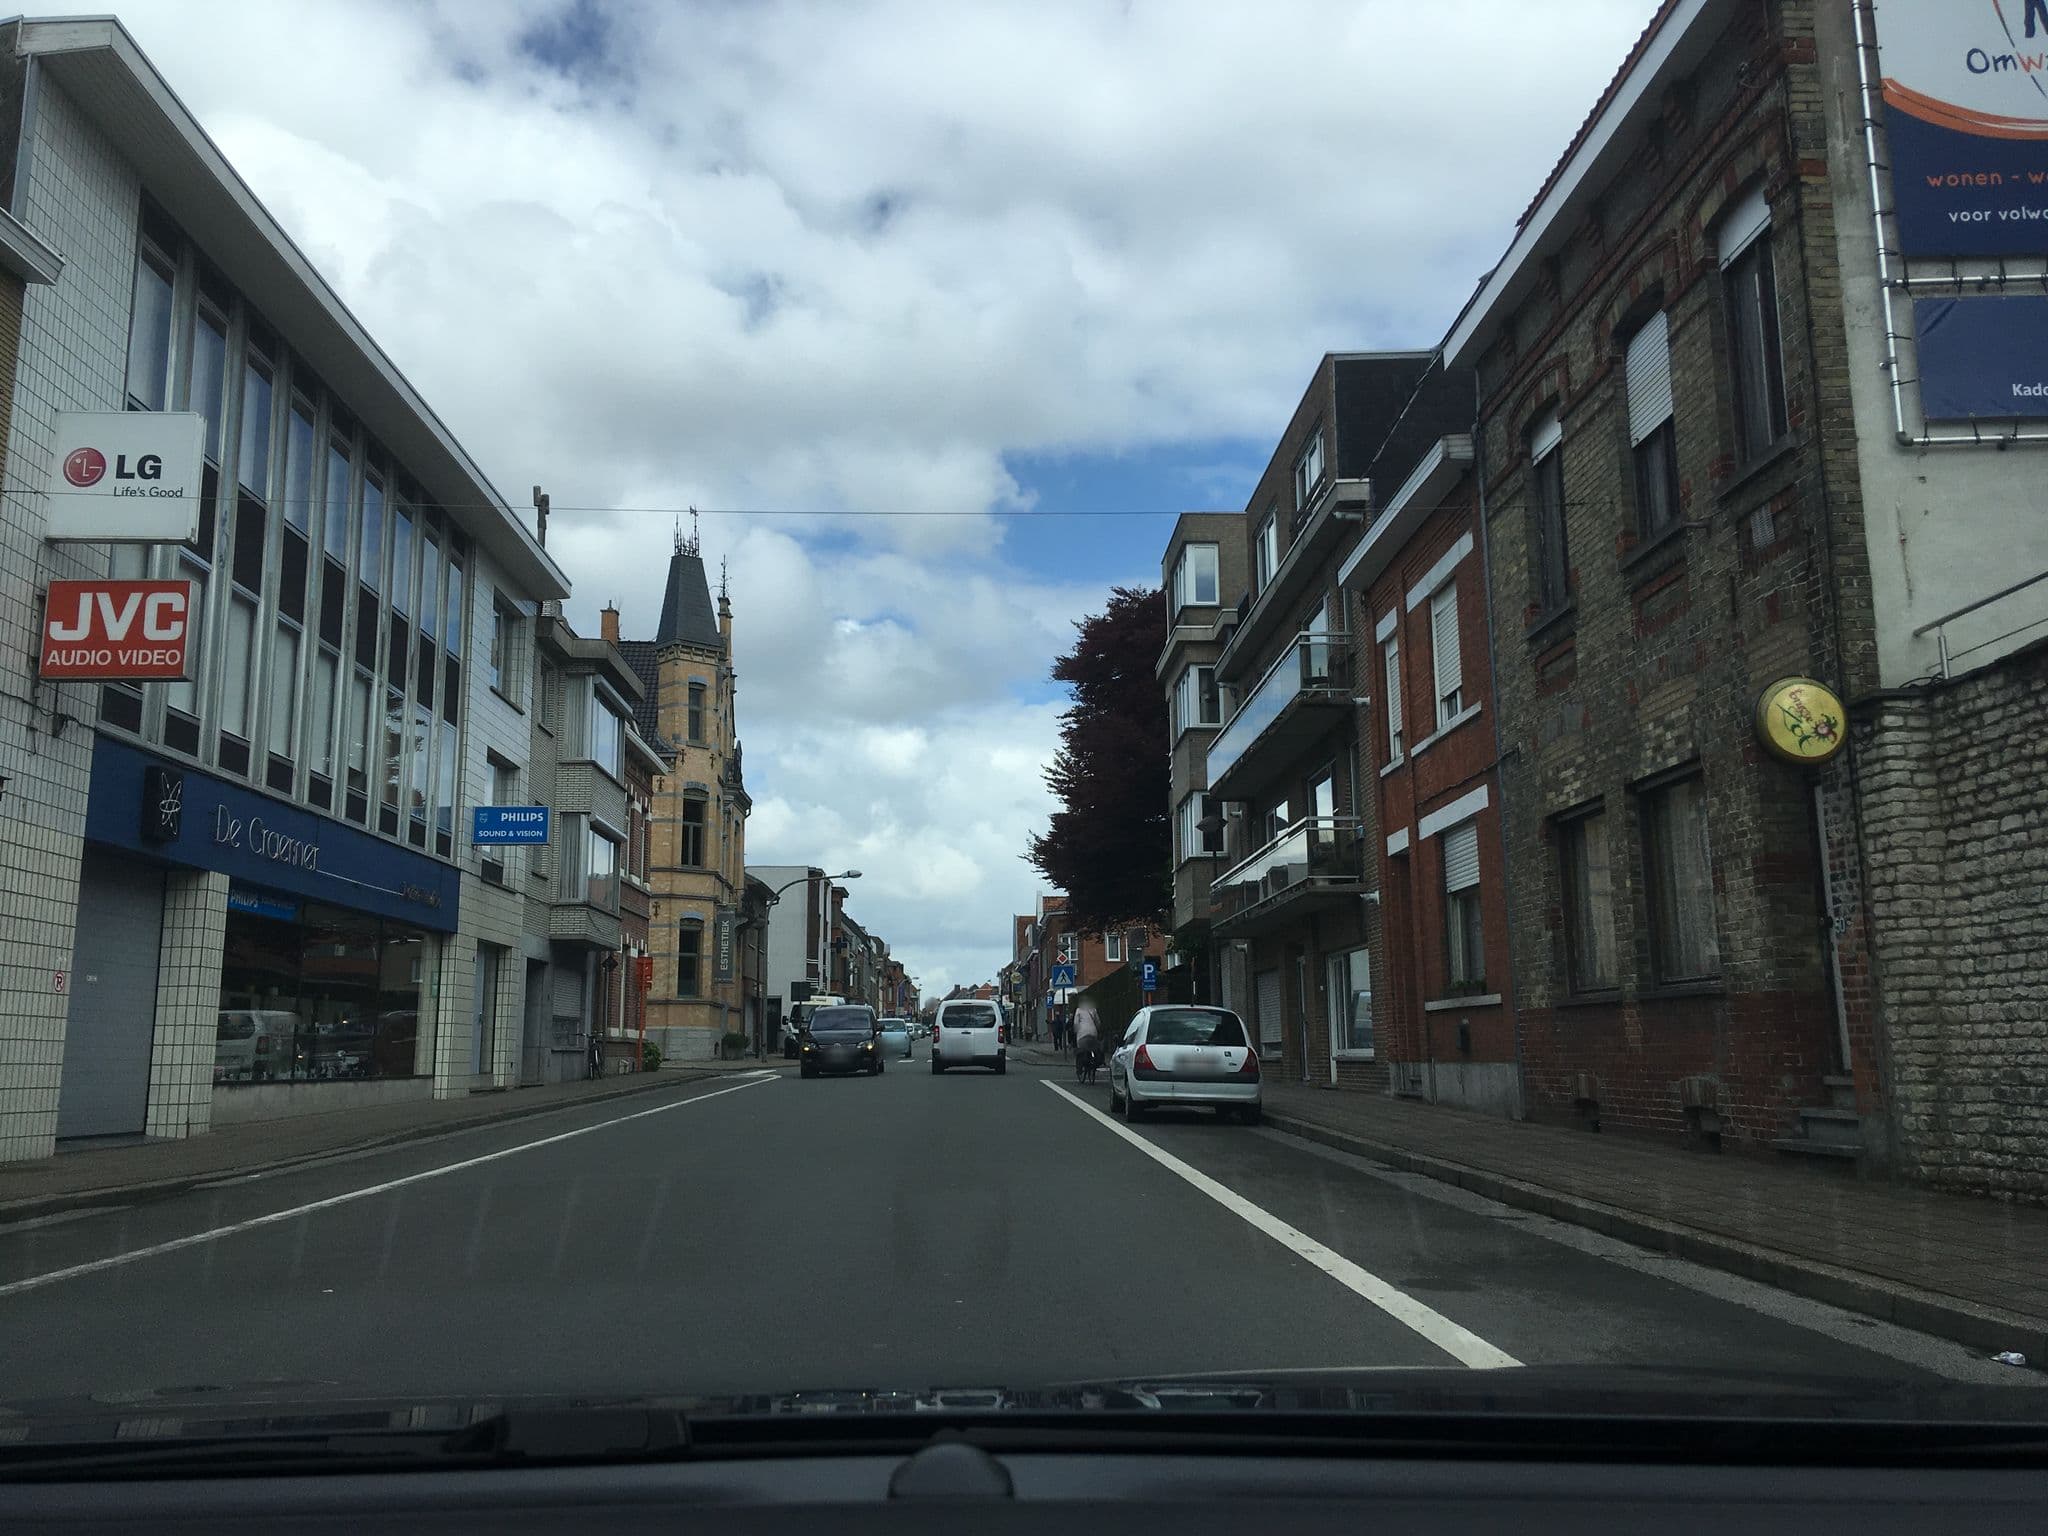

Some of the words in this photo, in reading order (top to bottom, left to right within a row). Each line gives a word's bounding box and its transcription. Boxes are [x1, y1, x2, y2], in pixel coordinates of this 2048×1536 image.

[1966, 47, 2048, 74] Omw
[1926, 171, 2002, 187] wonen
[2028, 171, 2048, 184] w
[1948, 210, 1991, 222] voor
[115, 454, 162, 480] LG
[113, 486, 146, 498] Life's
[148, 486, 183, 498] Good
[49, 592, 185, 641] JVC
[46, 649, 112, 666] AUDIO
[118, 649, 180, 666] VIDEO
[501, 812, 544, 822] PHILIPS
[215, 804, 242, 848] De
[720, 919, 730, 971] ESTHETIEK
[1143, 964, 1154, 979] P
